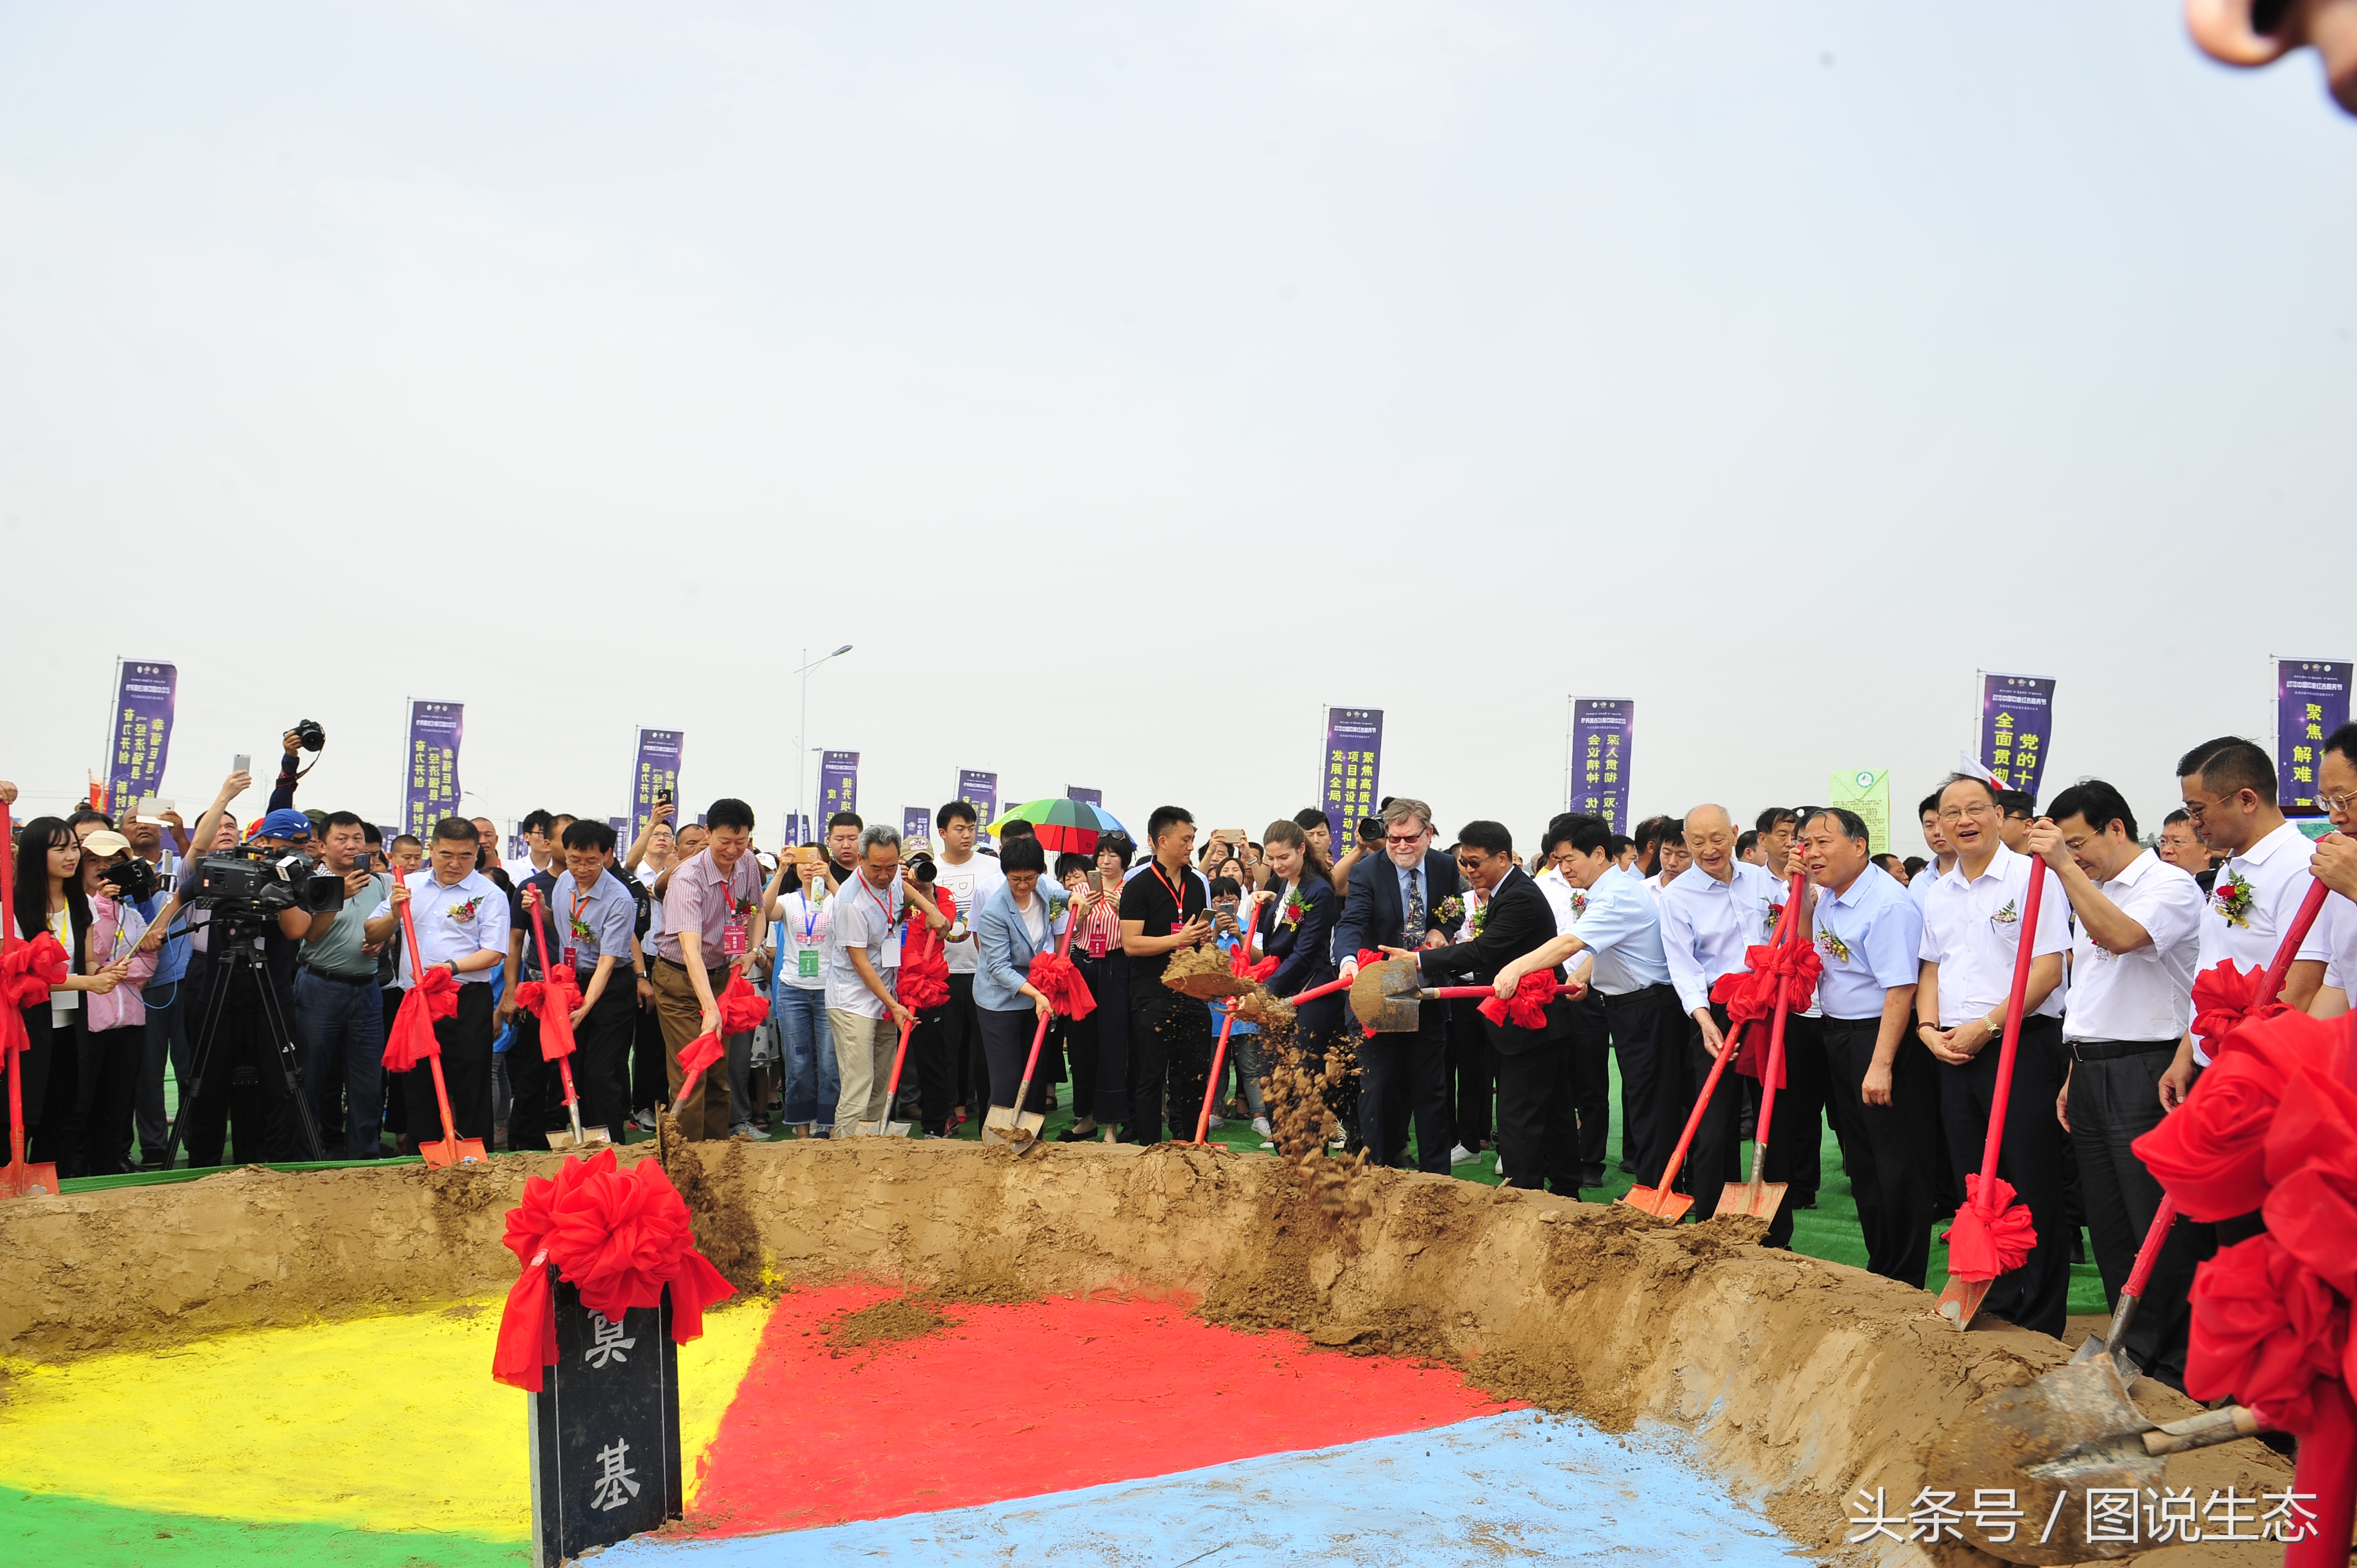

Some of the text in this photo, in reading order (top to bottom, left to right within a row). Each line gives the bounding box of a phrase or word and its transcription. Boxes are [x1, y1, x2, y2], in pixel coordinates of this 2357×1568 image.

[1993, 711, 2015, 783] 全面贯彻
[2306, 703, 2323, 740] 聚焦
[1357, 751, 1375, 823] 聚焦高质量
[2014, 733, 2040, 792] 党的十
[131, 864, 143, 877] 5
